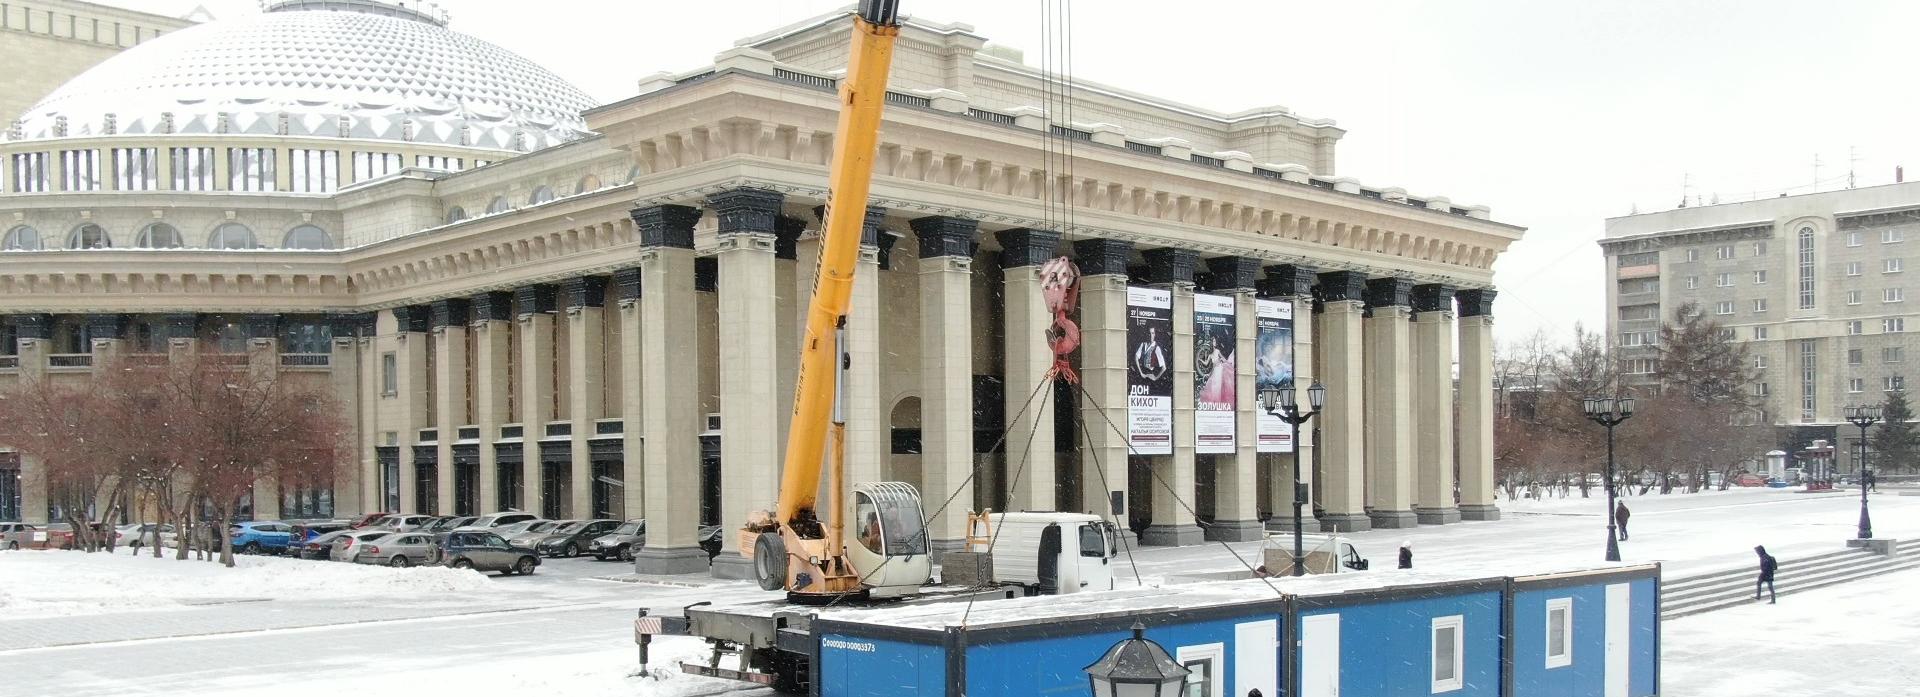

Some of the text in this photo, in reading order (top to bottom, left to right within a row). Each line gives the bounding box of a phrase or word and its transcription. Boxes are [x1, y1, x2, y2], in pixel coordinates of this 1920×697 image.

[1130, 384, 1150, 396] ДОН
[1130, 397, 1158, 407] КИХОТ
[1197, 401, 1231, 411] ЗОЛУШКА
